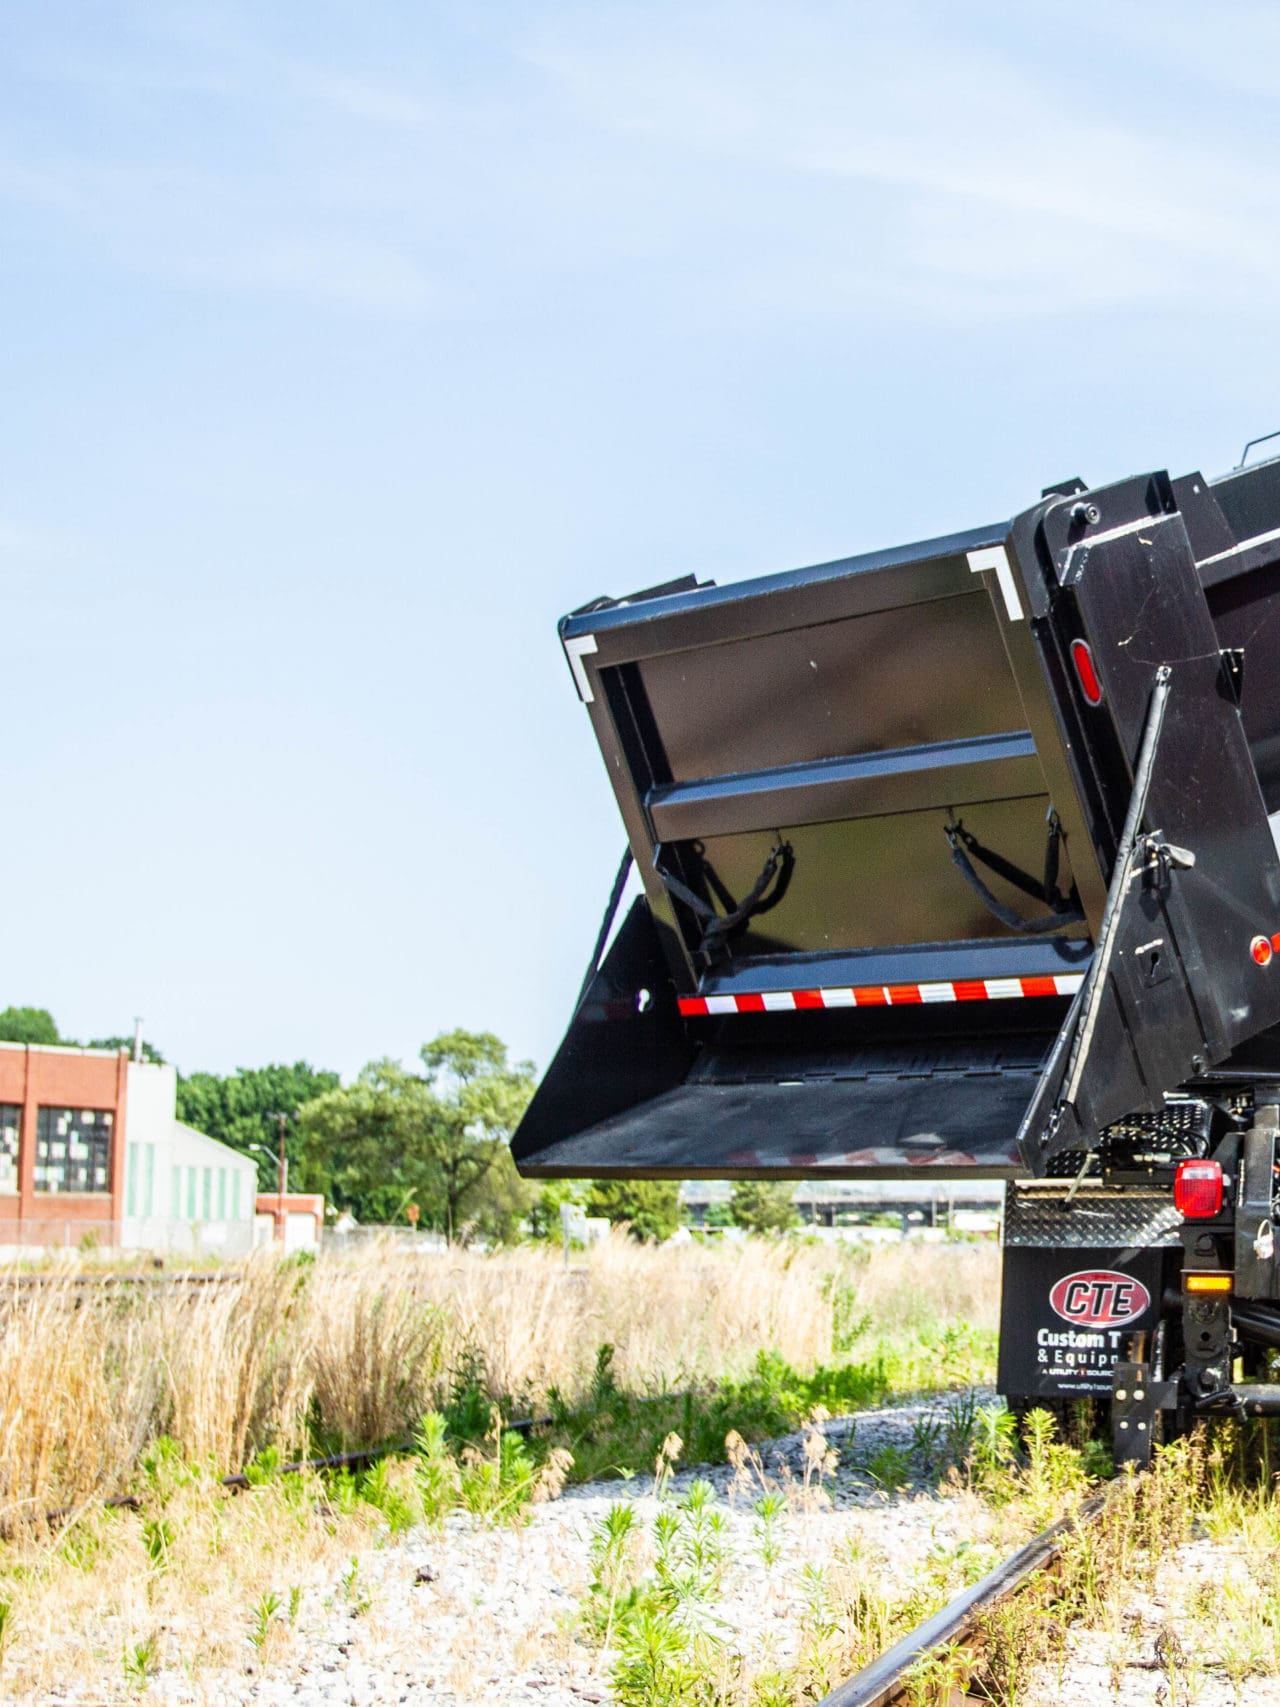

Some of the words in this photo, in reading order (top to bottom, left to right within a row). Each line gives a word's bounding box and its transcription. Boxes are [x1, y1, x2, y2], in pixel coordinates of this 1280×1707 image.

[1063, 1280, 1135, 1317] CTE
[1037, 1328, 1105, 1348] Custom
[1037, 1348, 1048, 1363] &
